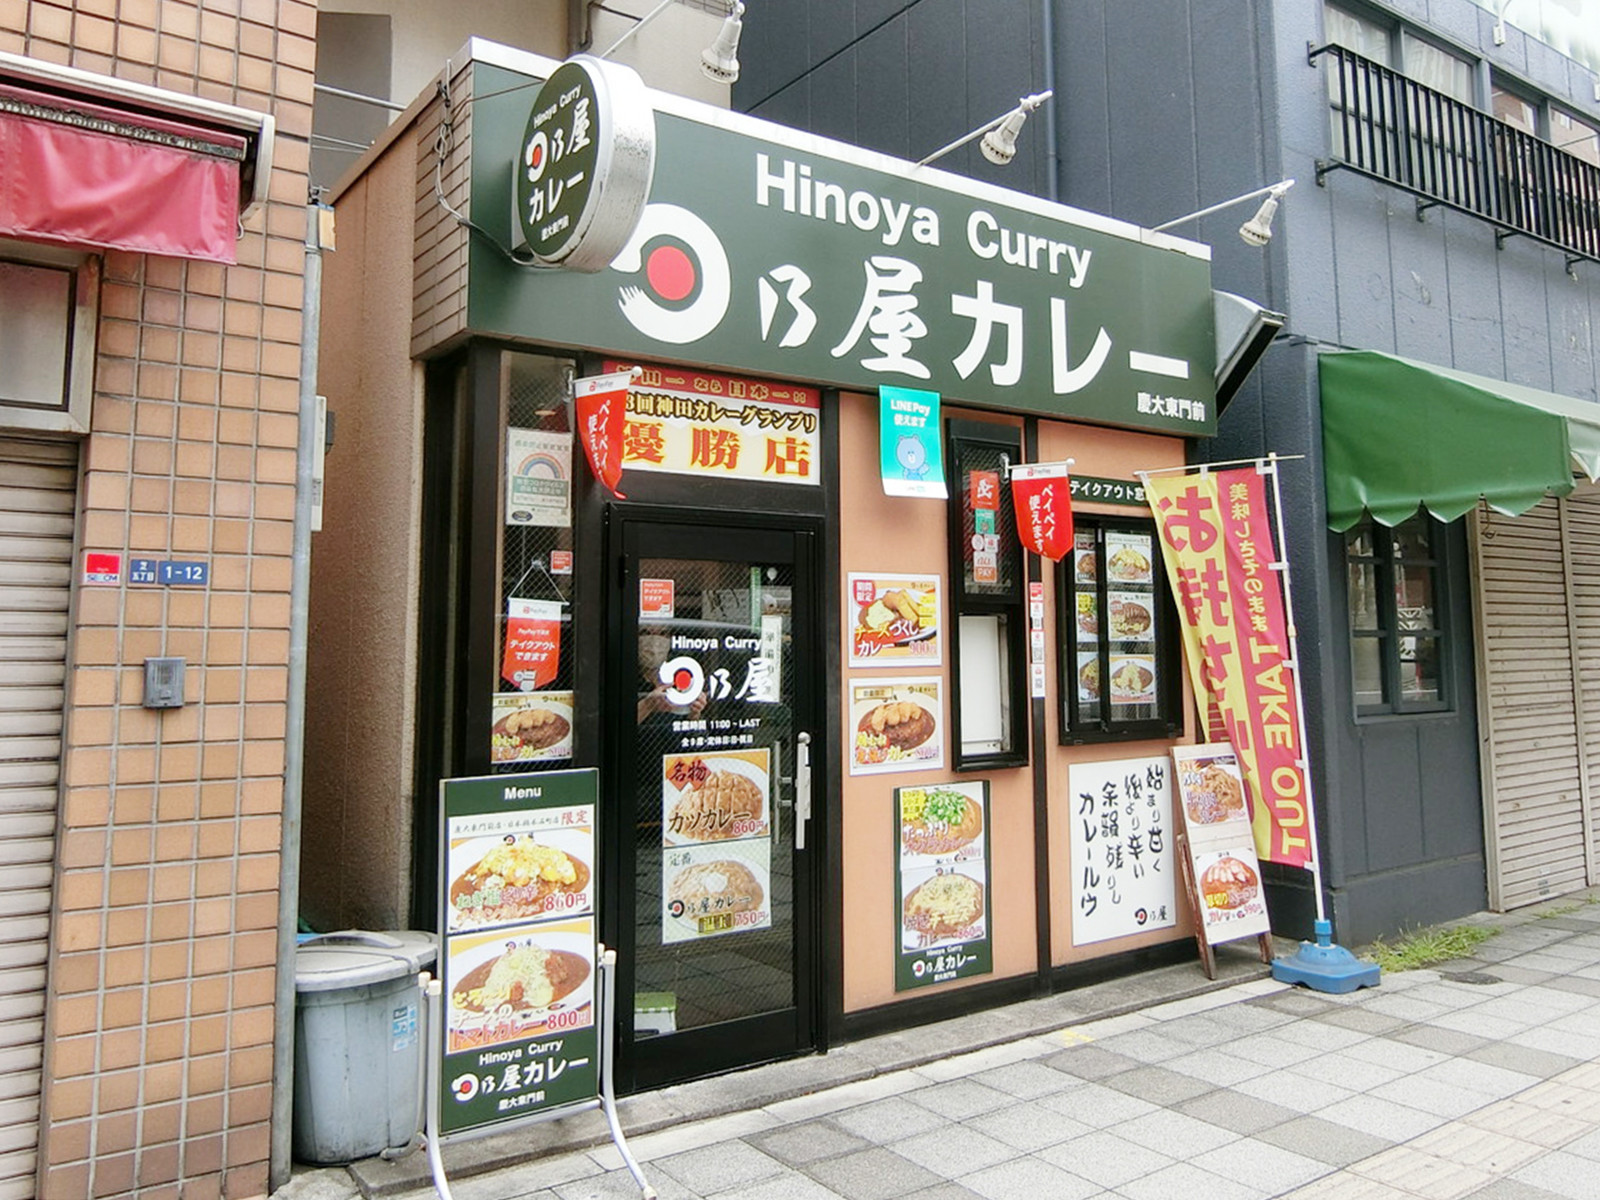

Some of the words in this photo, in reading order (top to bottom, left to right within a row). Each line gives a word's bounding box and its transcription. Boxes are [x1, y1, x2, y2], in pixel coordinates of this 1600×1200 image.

[534, 104, 558, 129] Hinoya
[559, 84, 582, 107] Curry
[528, 171, 585, 225] カレー
[755, 152, 940, 247] Hinoya
[966, 210, 1092, 288] Curry
[1137, 392, 1205, 422] 慶大東門前
[894, 413, 927, 428] 使えます
[599, 399, 611, 470] ペイペイ
[624, 420, 811, 478] 優勝店
[1042, 484, 1056, 541] ペイペイ
[165, 566, 202, 580] 1-12
[510, 640, 555, 651] テイクアウト
[671, 635, 719, 651] Hinoya
[724, 635, 762, 651] Curry
[858, 641, 895, 657] カレー
[710, 719, 730, 730] 11:00
[739, 718, 761, 728] LAST
[670, 760, 708, 783] 名物
[504, 786, 542, 800] Menu
[561, 810, 588, 826] 限定
[668, 807, 751, 834] カツカレー
[1079, 792, 1101, 918] カレールウ
[453, 1018, 543, 1048] トマトカレー
[479, 1048, 523, 1066] Hinoya
[528, 1040, 564, 1056] Curry
